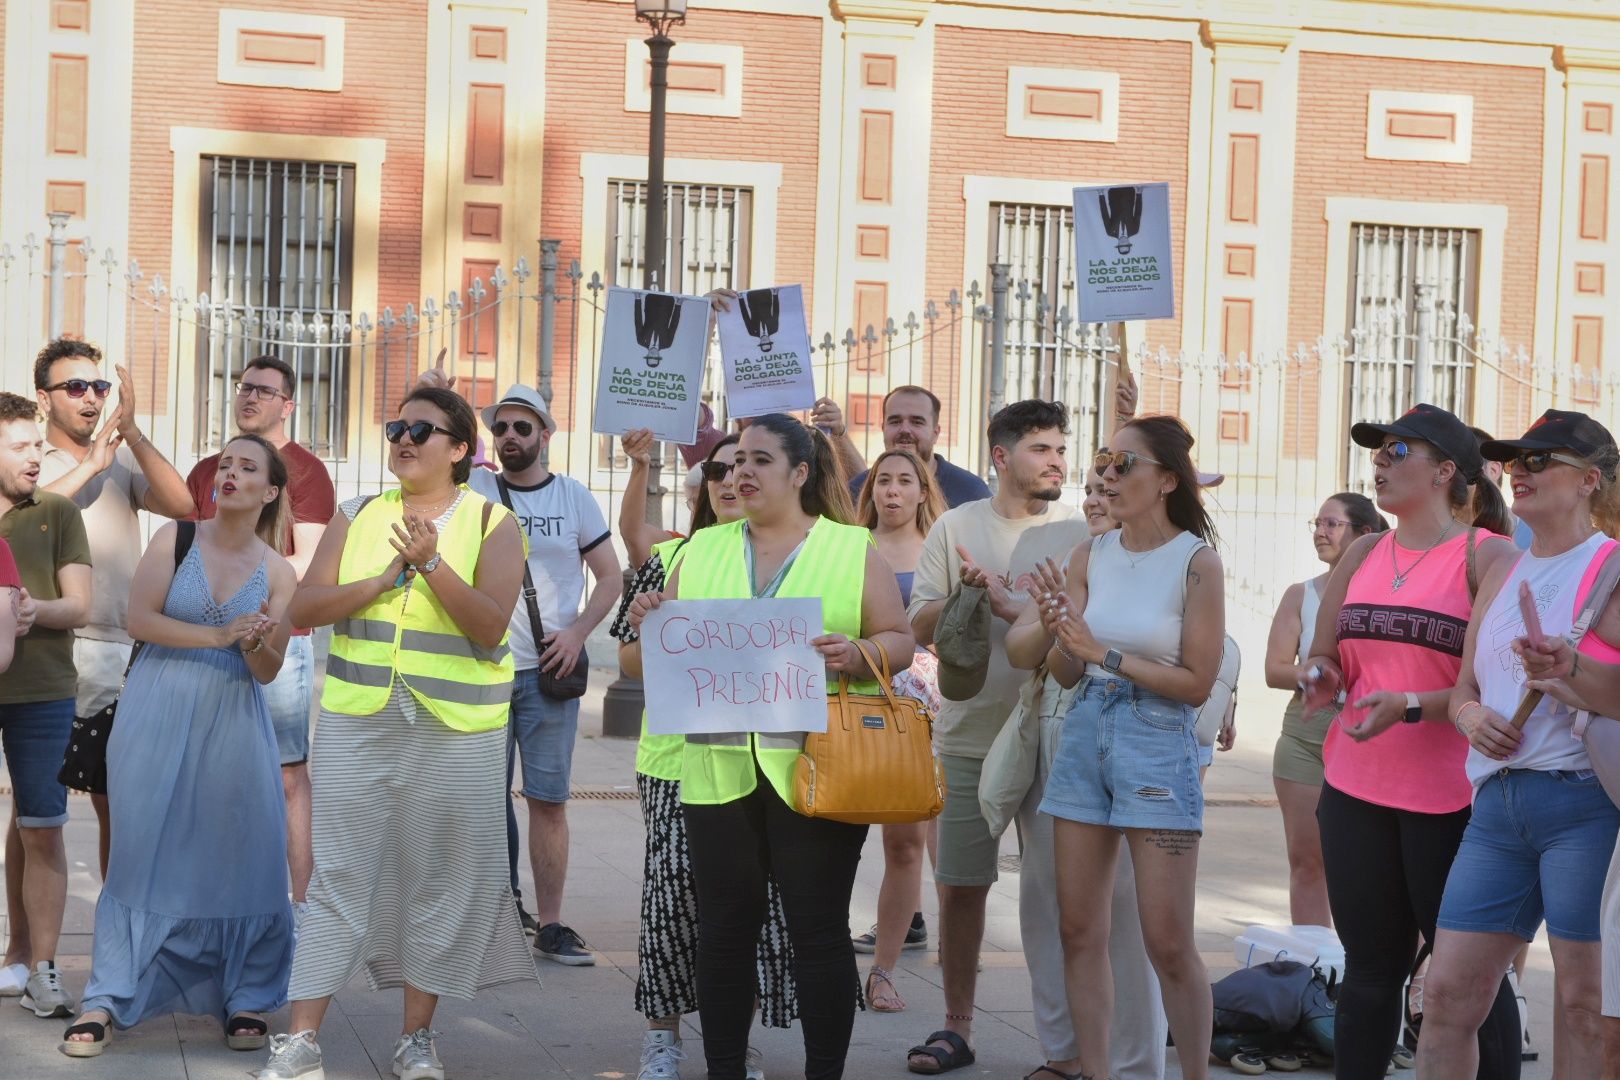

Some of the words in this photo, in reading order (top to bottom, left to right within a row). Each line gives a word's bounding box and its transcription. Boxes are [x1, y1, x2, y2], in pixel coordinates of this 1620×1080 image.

[1089, 259, 1106, 267] LA
[1112, 256, 1157, 265] JUNTA
[1089, 267, 1117, 276] NOS
[1122, 265, 1158, 274] DEJA
[1088, 273, 1160, 284] COLGADOS
[734, 358, 751, 366] LA
[755, 351, 798, 363] JUNTA
[735, 364, 761, 374] NOS
[765, 359, 799, 370] DEJA
[613, 367, 632, 376] LA
[637, 370, 686, 382] JUNTA
[734, 367, 802, 382] COLGADOS
[611, 376, 642, 387] NOS
[646, 380, 685, 392] DEJA
[608, 385, 687, 402] COLGADOS
[661, 616, 807, 654] CÓRDOBA
[687, 662, 820, 707] PRESENTE
